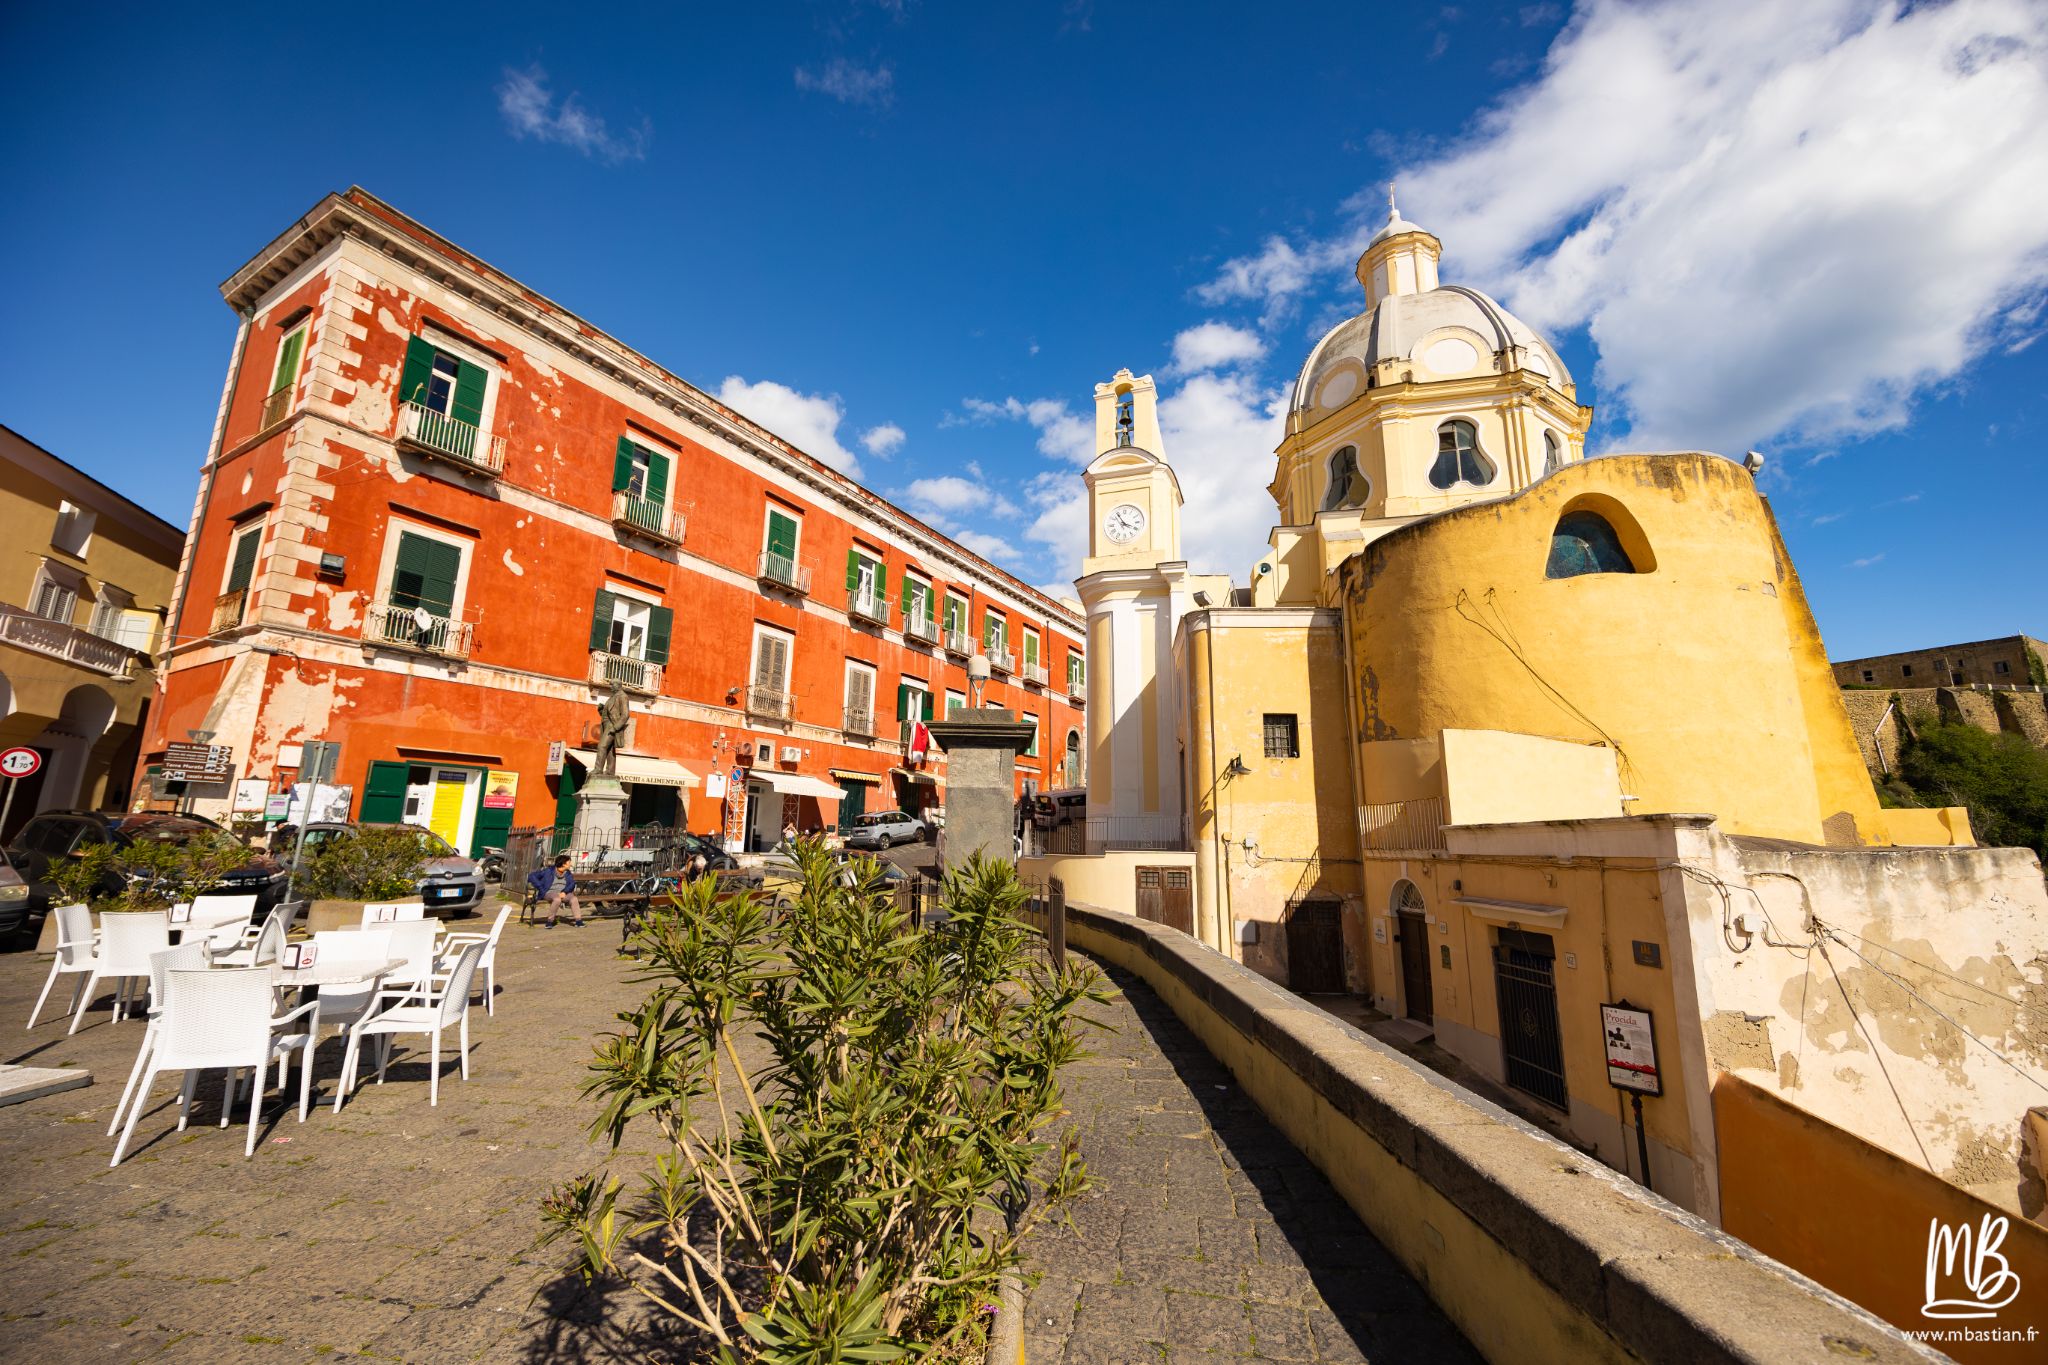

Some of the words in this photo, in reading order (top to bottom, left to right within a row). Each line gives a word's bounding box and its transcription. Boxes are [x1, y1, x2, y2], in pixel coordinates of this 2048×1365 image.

[10, 756, 17, 768] 1
[619, 775, 641, 783] ACCHI
[646, 777, 686, 786] ALIMENTARI
[1605, 1012, 1638, 1026] Procida
